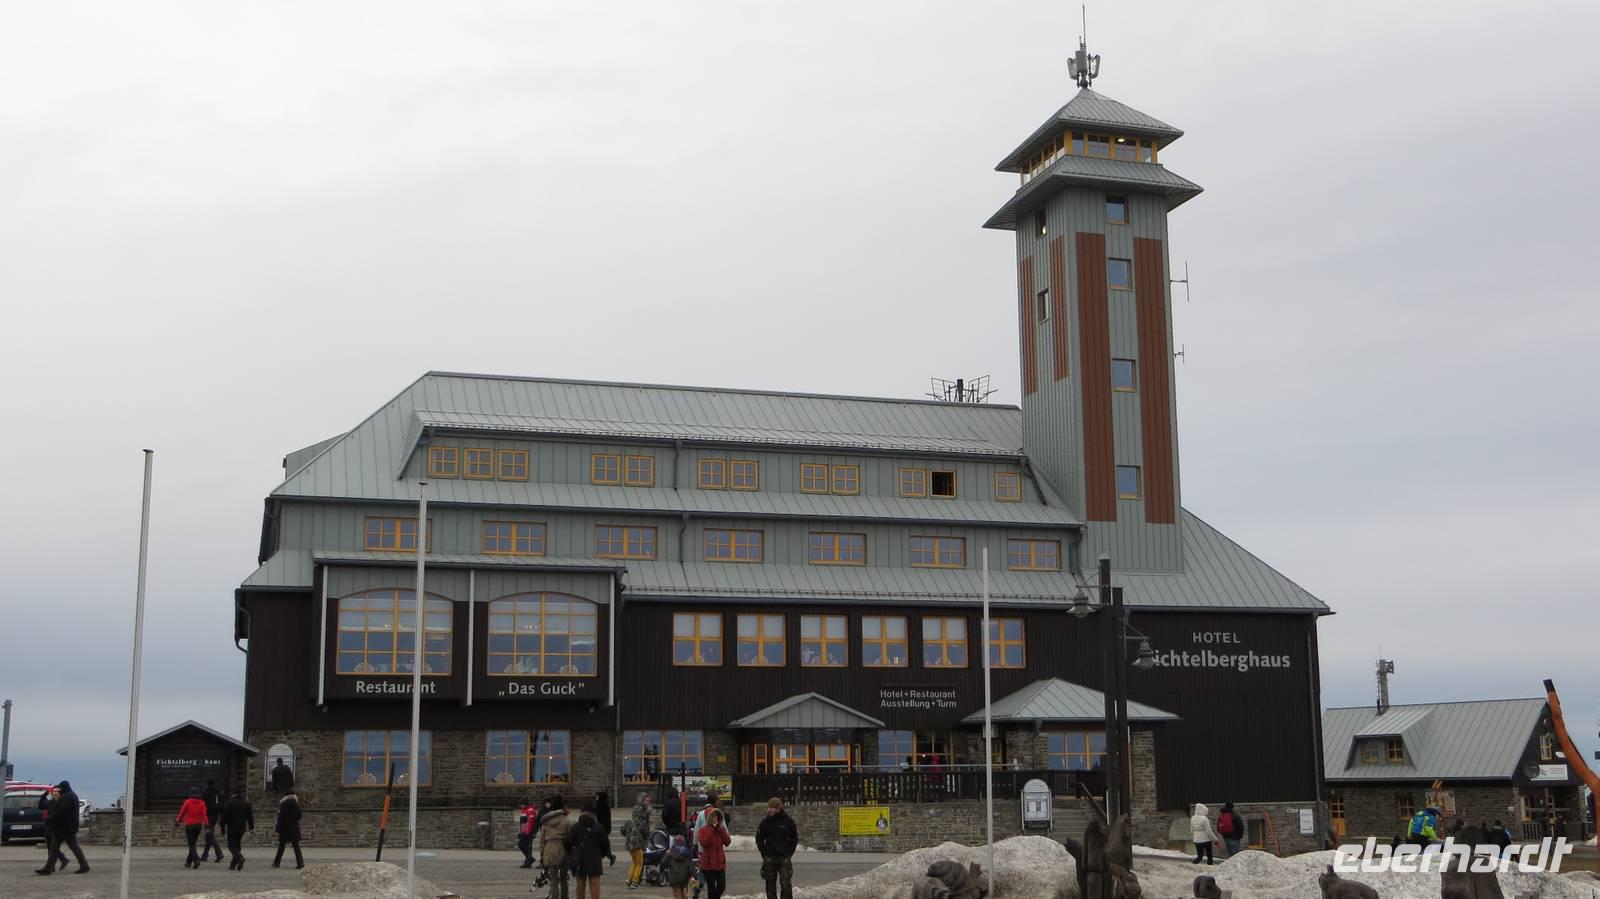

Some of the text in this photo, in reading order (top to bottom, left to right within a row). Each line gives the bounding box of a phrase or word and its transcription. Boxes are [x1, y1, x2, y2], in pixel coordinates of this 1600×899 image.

[1192, 631, 1241, 644] HOTEL
[1151, 649, 1291, 672] ichtelberghaus
[356, 680, 436, 694] Restaurnt
